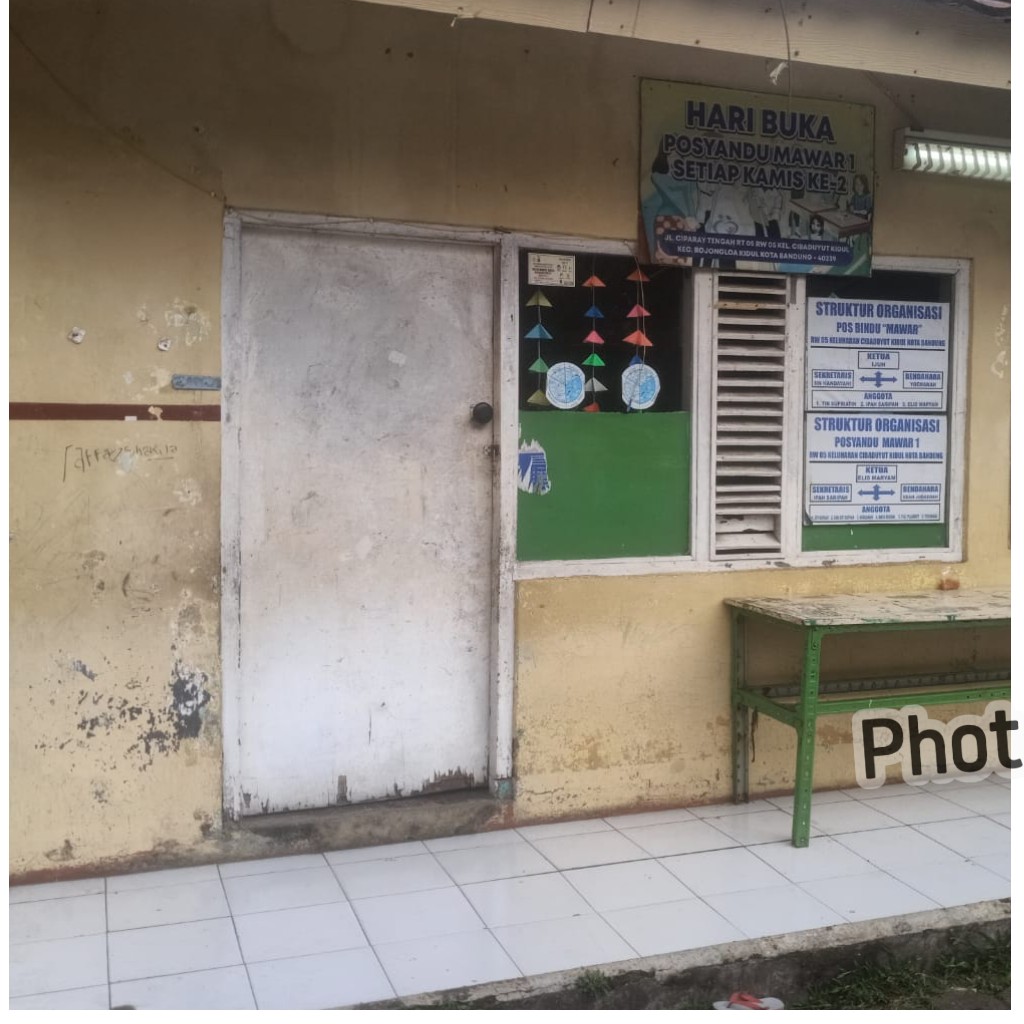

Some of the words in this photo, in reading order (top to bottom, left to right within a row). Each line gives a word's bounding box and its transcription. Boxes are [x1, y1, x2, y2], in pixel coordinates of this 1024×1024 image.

[685, 100, 755, 133] HARI
[761, 109, 835, 142] BUKA
[663, 134, 771, 162] POSYANDU
[774, 147, 846, 170] MAWAR
[848, 154, 856, 172] 1
[673, 160, 739, 183] SETIAP
[743, 167, 804, 190] KAMIS
[807, 174, 848, 194] KE-2
[675, 235, 706, 244] CIPARAY
[707, 238, 735, 247] TENGAH
[735, 239, 745, 247] RT
[755, 241, 767, 249] RW
[792, 243, 830, 252] CIBADUYUT
[830, 245, 850, 253] KIDUL
[677, 246, 693, 254] KEC.
[694, 247, 738, 256] BOJONGLOA
[739, 250, 759, 258] KIDUL
[760, 251, 778, 259] KOTA
[779, 252, 812, 261] BANDUNG
[816, 301, 874, 318] STRUKTUR
[877, 303, 942, 320] ORGANISASI
[836, 322, 853, 333] POS
[855, 323, 881, 334] BINDU
[810, 336, 820, 344] RW
[860, 337, 890, 346] CIBADUYUT
[867, 352, 890, 360] KETUA
[814, 371, 852, 379] SEKRETARIS
[905, 372, 941, 380] BENDAHARA
[814, 417, 873, 432] STRUKTUR
[875, 418, 940, 433] ORGANISASI
[834, 437, 879, 448] POSYANDU
[882, 437, 912, 448] MAWAR
[915, 438, 920, 448] 1
[859, 451, 888, 459] CIBADUYUT
[865, 466, 888, 474] KETUA
[812, 486, 850, 494] SEKRETARIS
[903, 485, 939, 493] BENDAHARA
